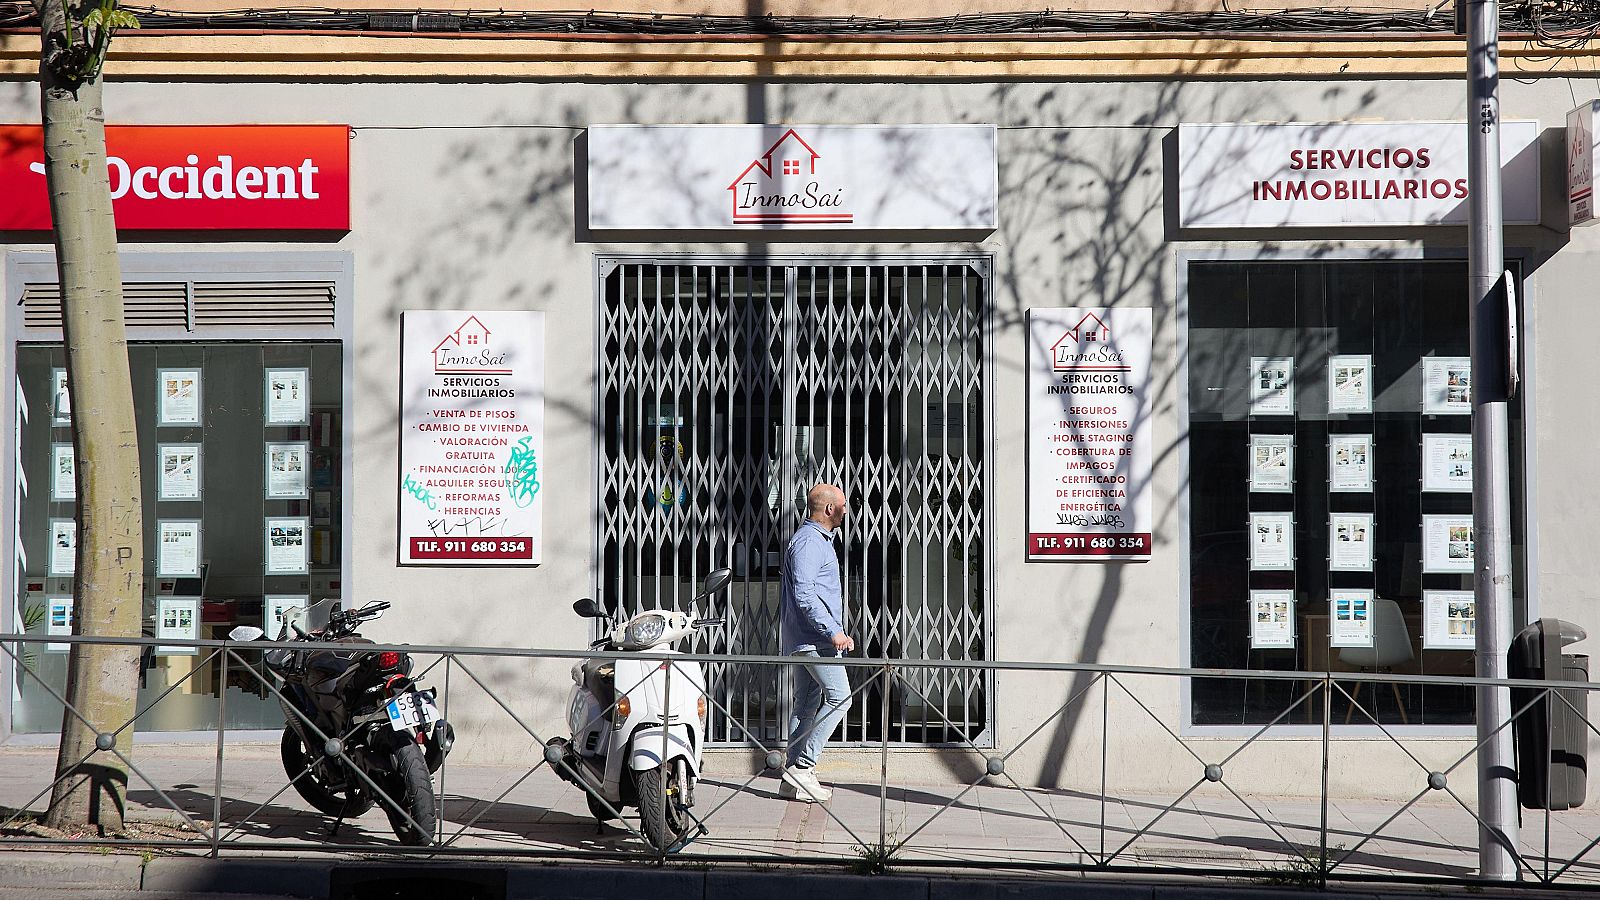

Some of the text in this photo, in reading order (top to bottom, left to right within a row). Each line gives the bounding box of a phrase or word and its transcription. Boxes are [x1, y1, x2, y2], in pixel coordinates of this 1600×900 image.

[1289, 147, 1431, 170] SERVICIOS
[106, 154, 320, 200] Occident
[1252, 178, 1469, 201] INMOBILIARIOS
[738, 181, 843, 209] InmoSai
[438, 348, 507, 366] InmoSai
[1057, 345, 1125, 363] InmoSai
[443, 377, 500, 387] SERVICIOS
[1062, 374, 1119, 384] SERVICIOS
[428, 388, 515, 398] INMOBILIARIOS
[1047, 385, 1134, 395] INMOBILIARIOS
[433, 409, 516, 419] VENTA DE PISOS
[1069, 406, 1117, 415] SEGUROS
[418, 423, 529, 433] CAMBIO DE VIVIENDA
[1060, 420, 1128, 429] INVERSIONES
[440, 436, 508, 446] VALORACIÓN
[1053, 434, 1134, 442] HOME STAGING
[445, 451, 495, 460] GRATUITA
[1056, 448, 1132, 456] COBERTURA DE
[419, 464, 496, 474] FINANCIACIÓN
[1066, 461, 1115, 470] IMPAGOS
[426, 479, 520, 488] ALQUILER SEGURO
[1062, 475, 1126, 484] CERTIFICADO
[445, 493, 501, 502] REFORMAS
[1056, 489, 1126, 498] DE EFICIENCIA
[444, 507, 501, 516] HERENCIAS
[1060, 501, 1121, 512] ENERGÉTICA
[417, 541, 526, 552] TLF. 911 680 354
[1037, 537, 1144, 548] TLF. 911 680 354
[398, 692, 432, 710] 5935
